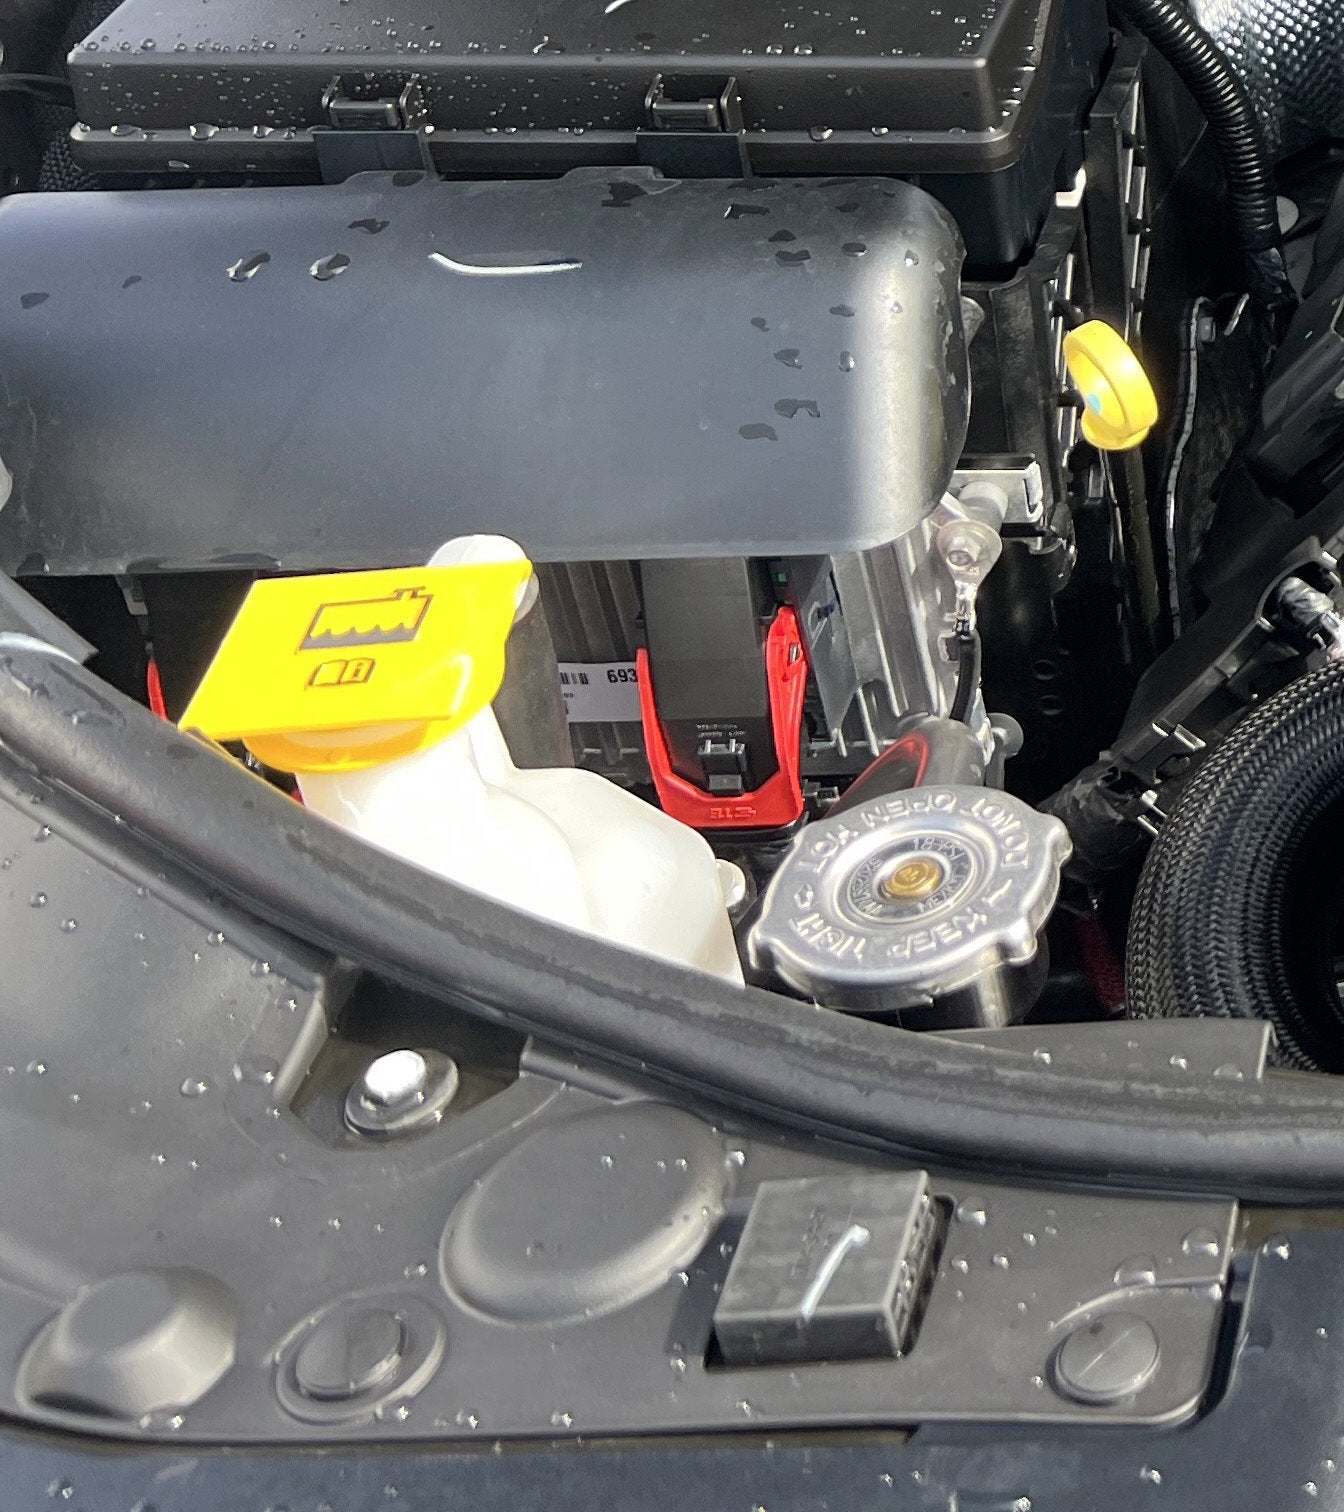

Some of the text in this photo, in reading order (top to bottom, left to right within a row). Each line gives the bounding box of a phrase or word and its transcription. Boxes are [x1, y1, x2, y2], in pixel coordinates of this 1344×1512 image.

[860, 792, 957, 828] OPEN
[798, 824, 858, 874] HOT
[789, 907, 988, 960] KEEP TIGHT
